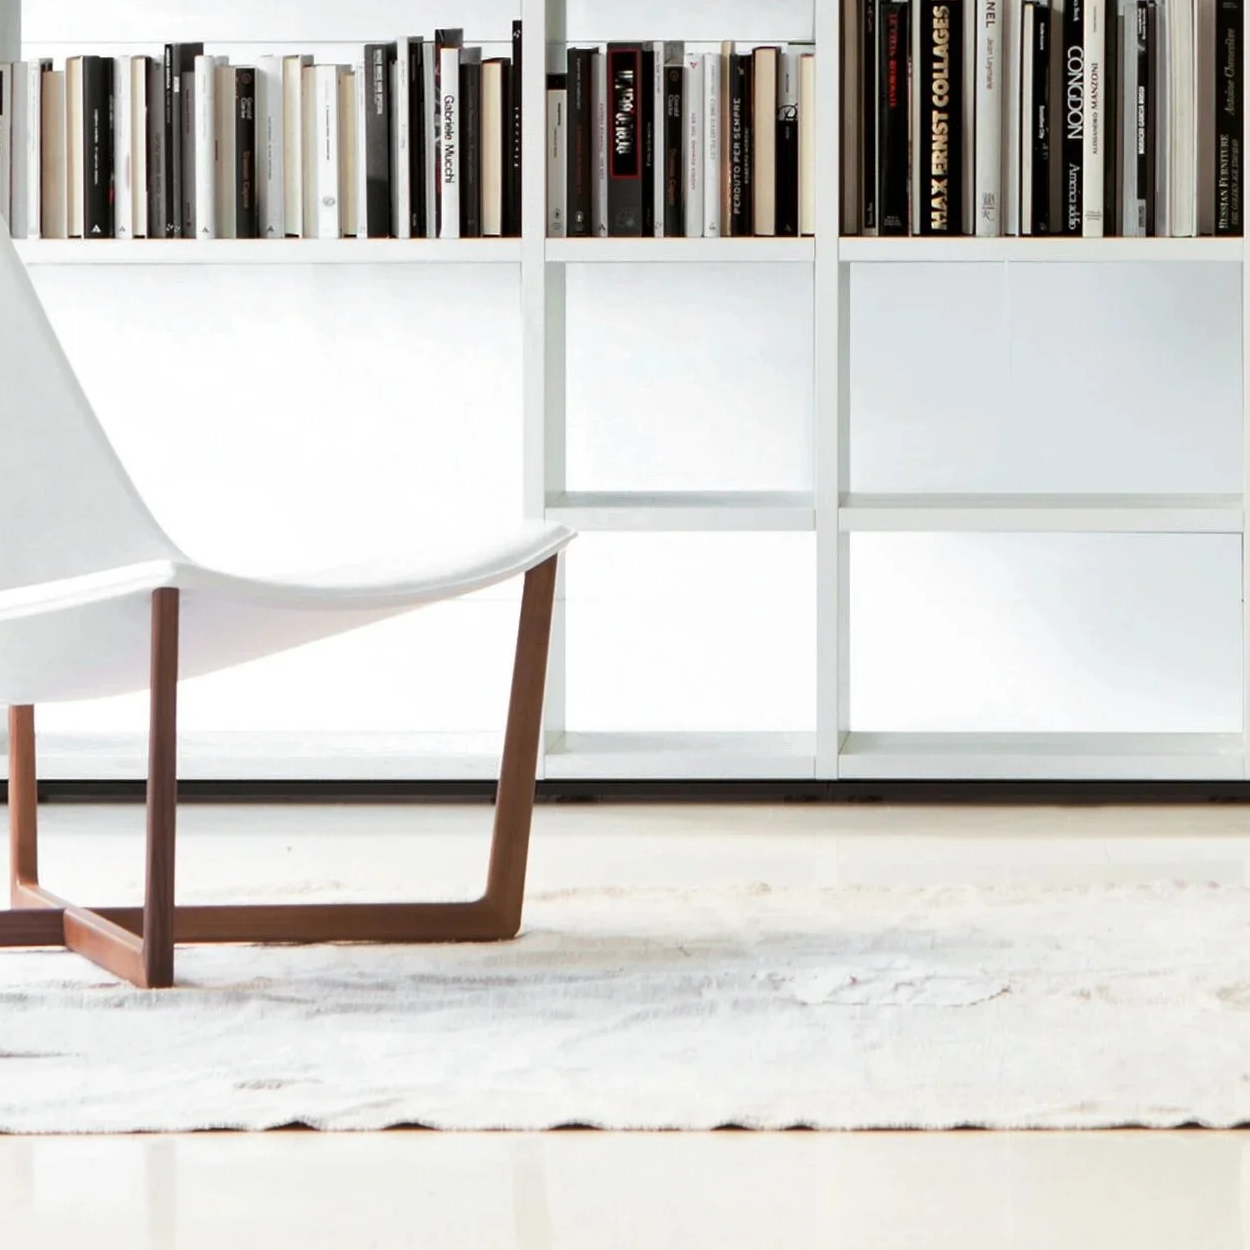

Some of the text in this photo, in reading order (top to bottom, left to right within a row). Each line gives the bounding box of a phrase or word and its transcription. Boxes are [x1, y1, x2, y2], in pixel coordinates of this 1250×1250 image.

[986, 37, 995, 54] Jean
[1090, 62, 1099, 110] MANZONI
[931, 5, 950, 230] MAX ERNST COLLAGES
[1067, 46, 1084, 139] CONGDON
[444, 94, 455, 184] Gabriele Mucchi
[733, 97, 741, 215] PERDUTO PER SEMPRE
[1068, 163, 1081, 203] America
[1218, 134, 1229, 229] RUSSIAN FURNITURE
[1068, 203, 1081, 230] addio
